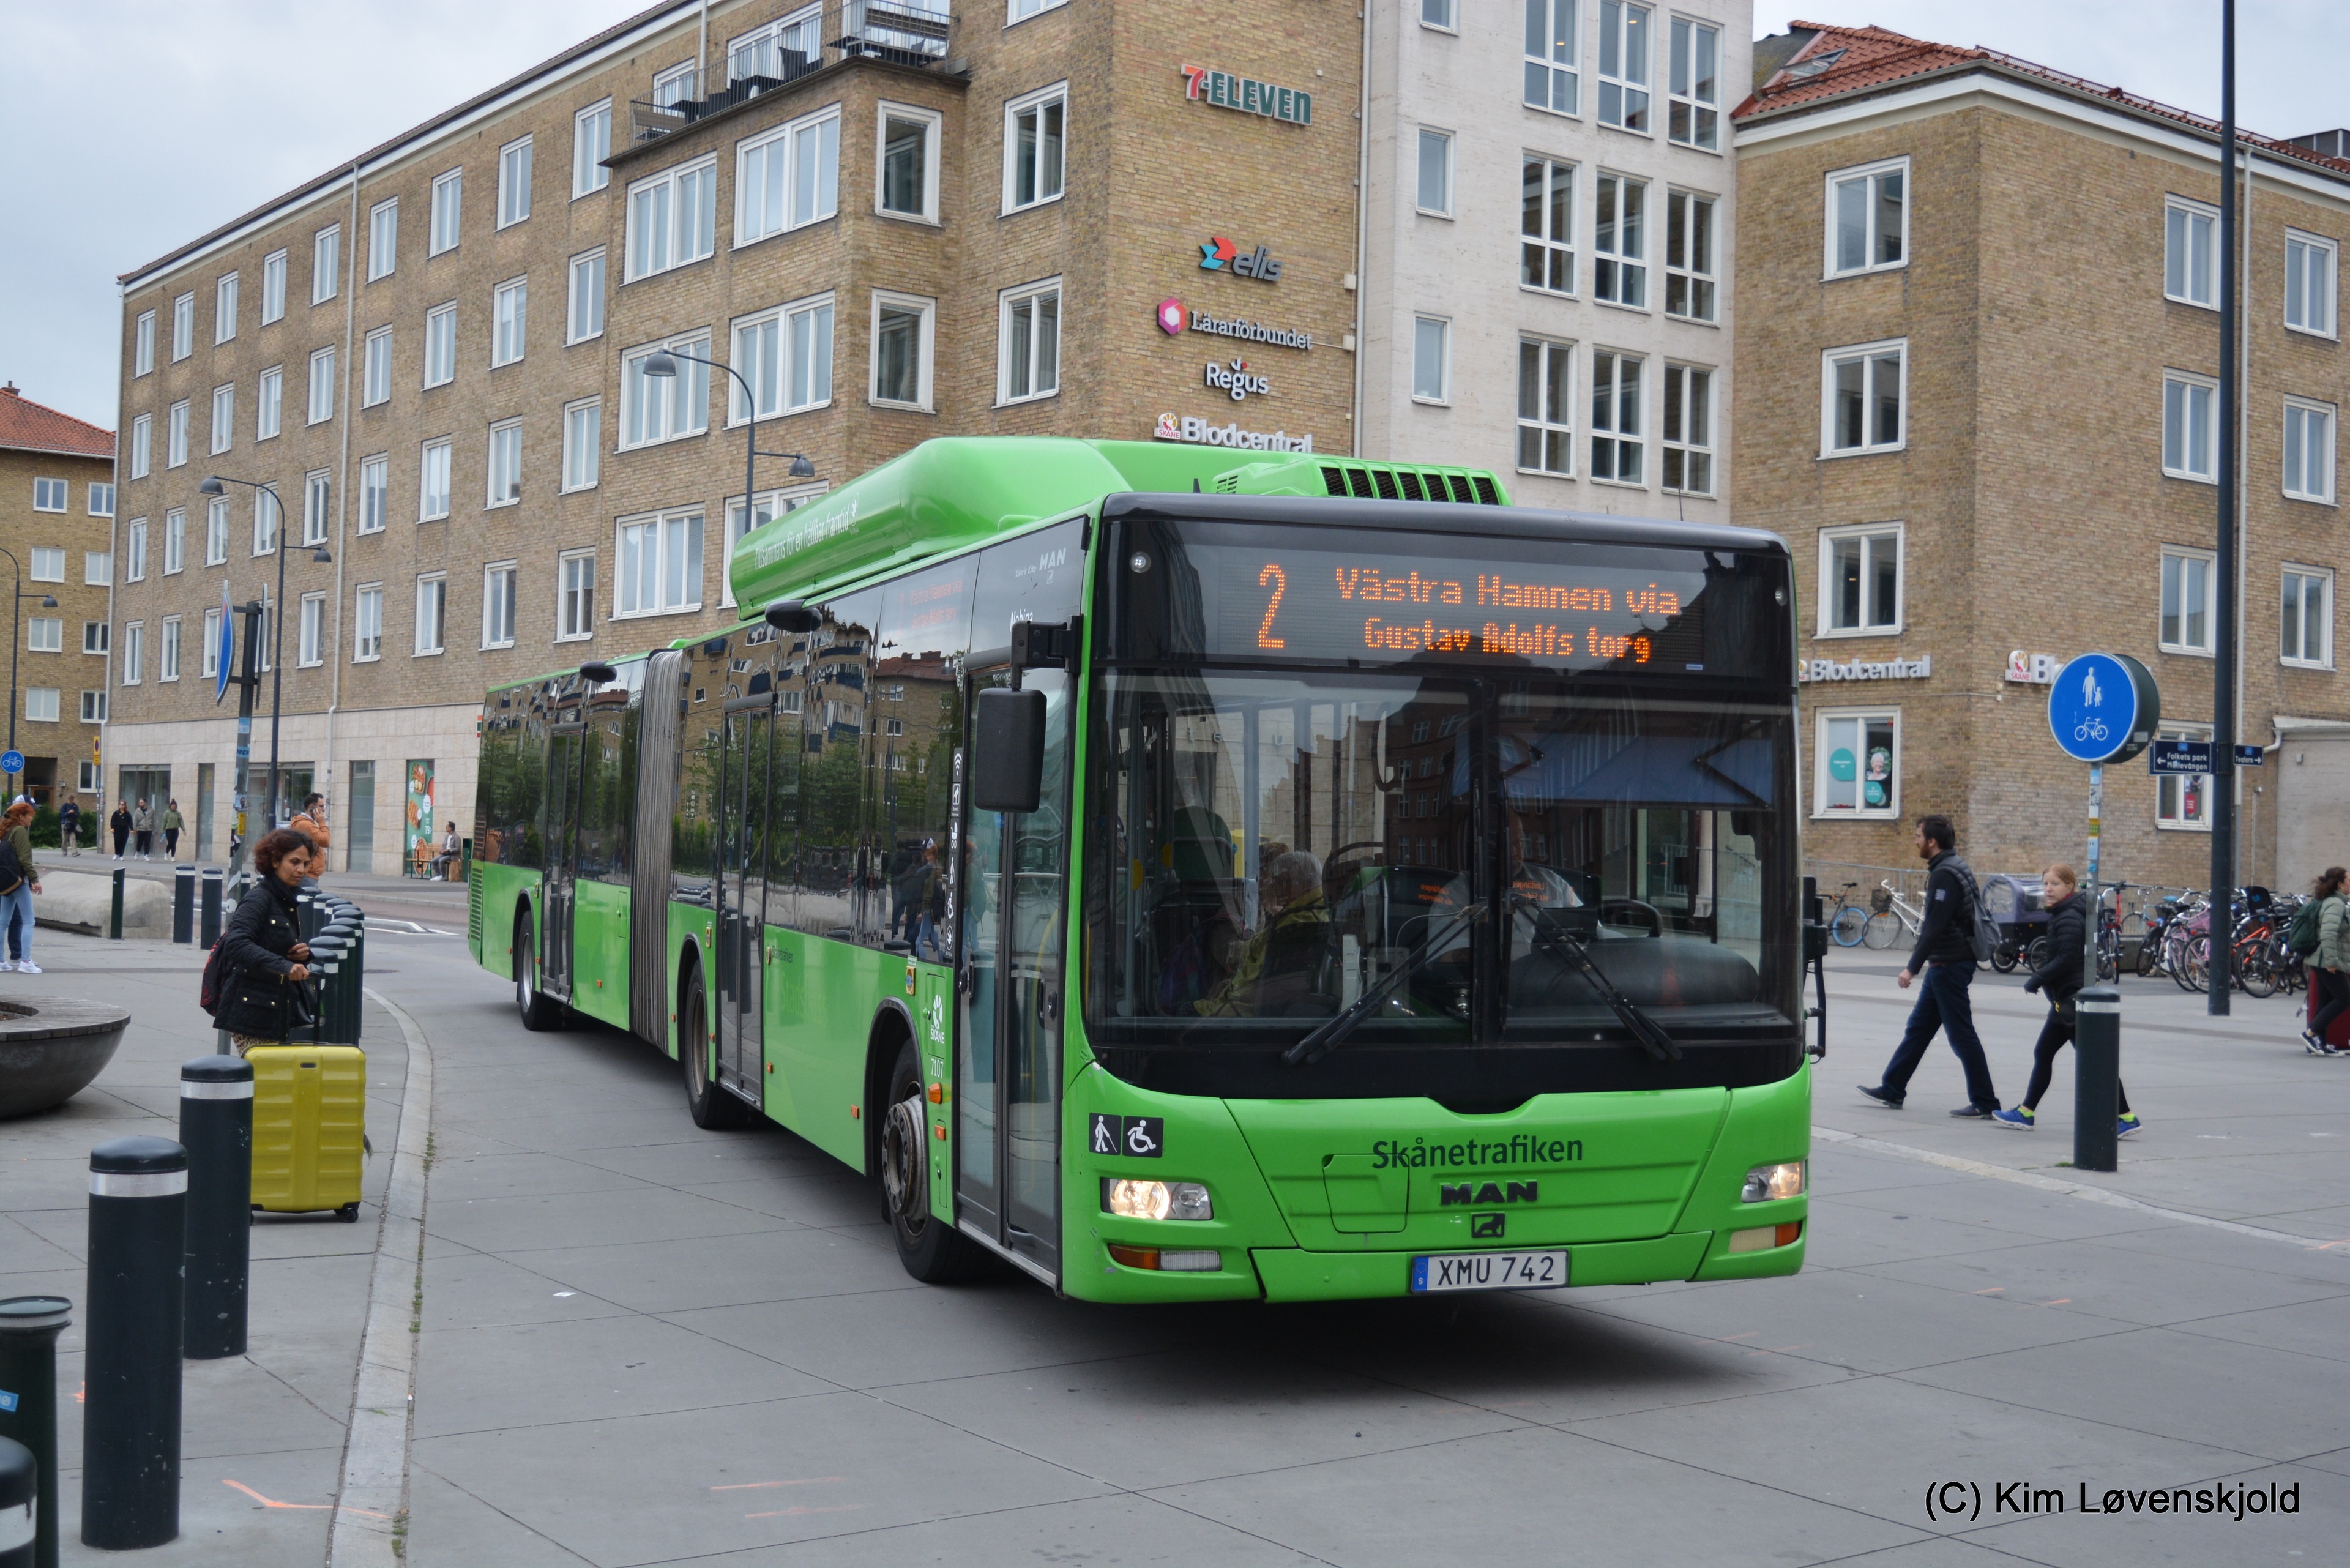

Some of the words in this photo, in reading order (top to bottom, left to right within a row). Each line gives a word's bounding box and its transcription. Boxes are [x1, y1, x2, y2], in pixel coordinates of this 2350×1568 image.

[1233, 245, 1283, 282] elis
[1192, 311, 1313, 350] Lärarförbundet
[1206, 359, 1269, 400] Regus
[1181, 417, 1313, 453] Blodcentral
[1039, 548, 1067, 571] MAN
[1258, 564, 1286, 648] 2
[1335, 567, 1463, 604] Västra
[1478, 574, 1611, 611] Hamnen
[1626, 584, 1680, 614] via
[1364, 617, 1469, 652] Gustav
[1482, 622, 1574, 656] Adolfs
[1586, 626, 1651, 663] torg
[1810, 655, 1931, 681] Blodcentral
[2166, 752, 2190, 761] Folkets
[2192, 754, 2207, 763] park
[931, 1058, 944, 1078] 7107
[1371, 1134, 1583, 1169] Skånetrafiken
[1439, 1179, 1538, 1206] MAN
[1417, 1277, 1424, 1285] S
[1437, 1258, 1491, 1286] XMU
[1501, 1256, 1554, 1283] 742
